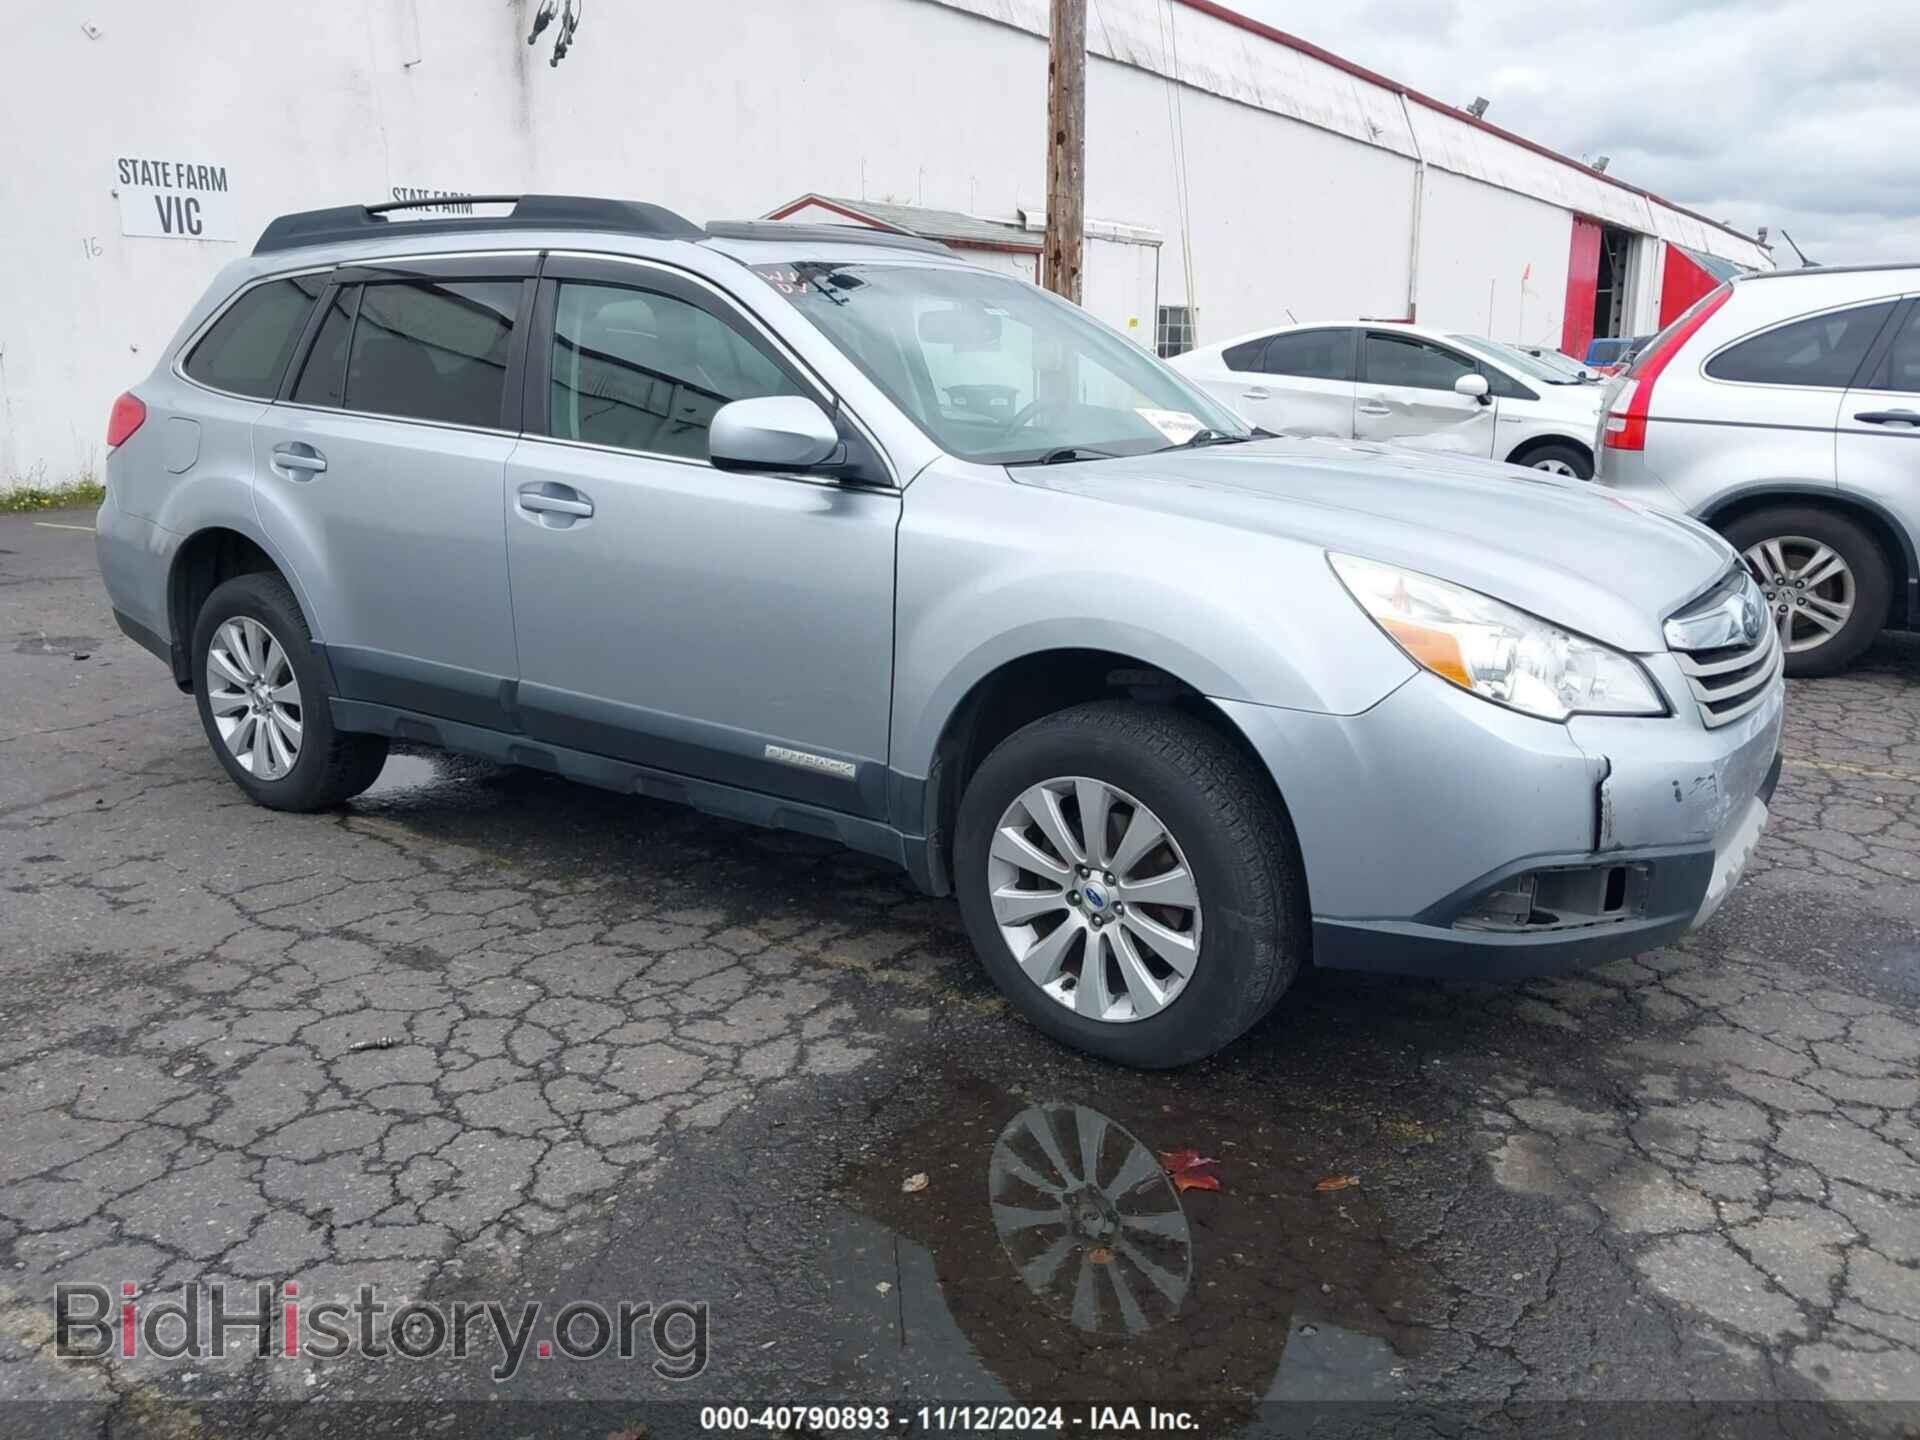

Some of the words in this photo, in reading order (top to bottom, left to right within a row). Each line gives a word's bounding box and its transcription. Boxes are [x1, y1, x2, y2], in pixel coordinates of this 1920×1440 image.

[118, 158, 173, 188] STATE
[176, 163, 228, 192] FARM
[154, 194, 203, 235] VIC
